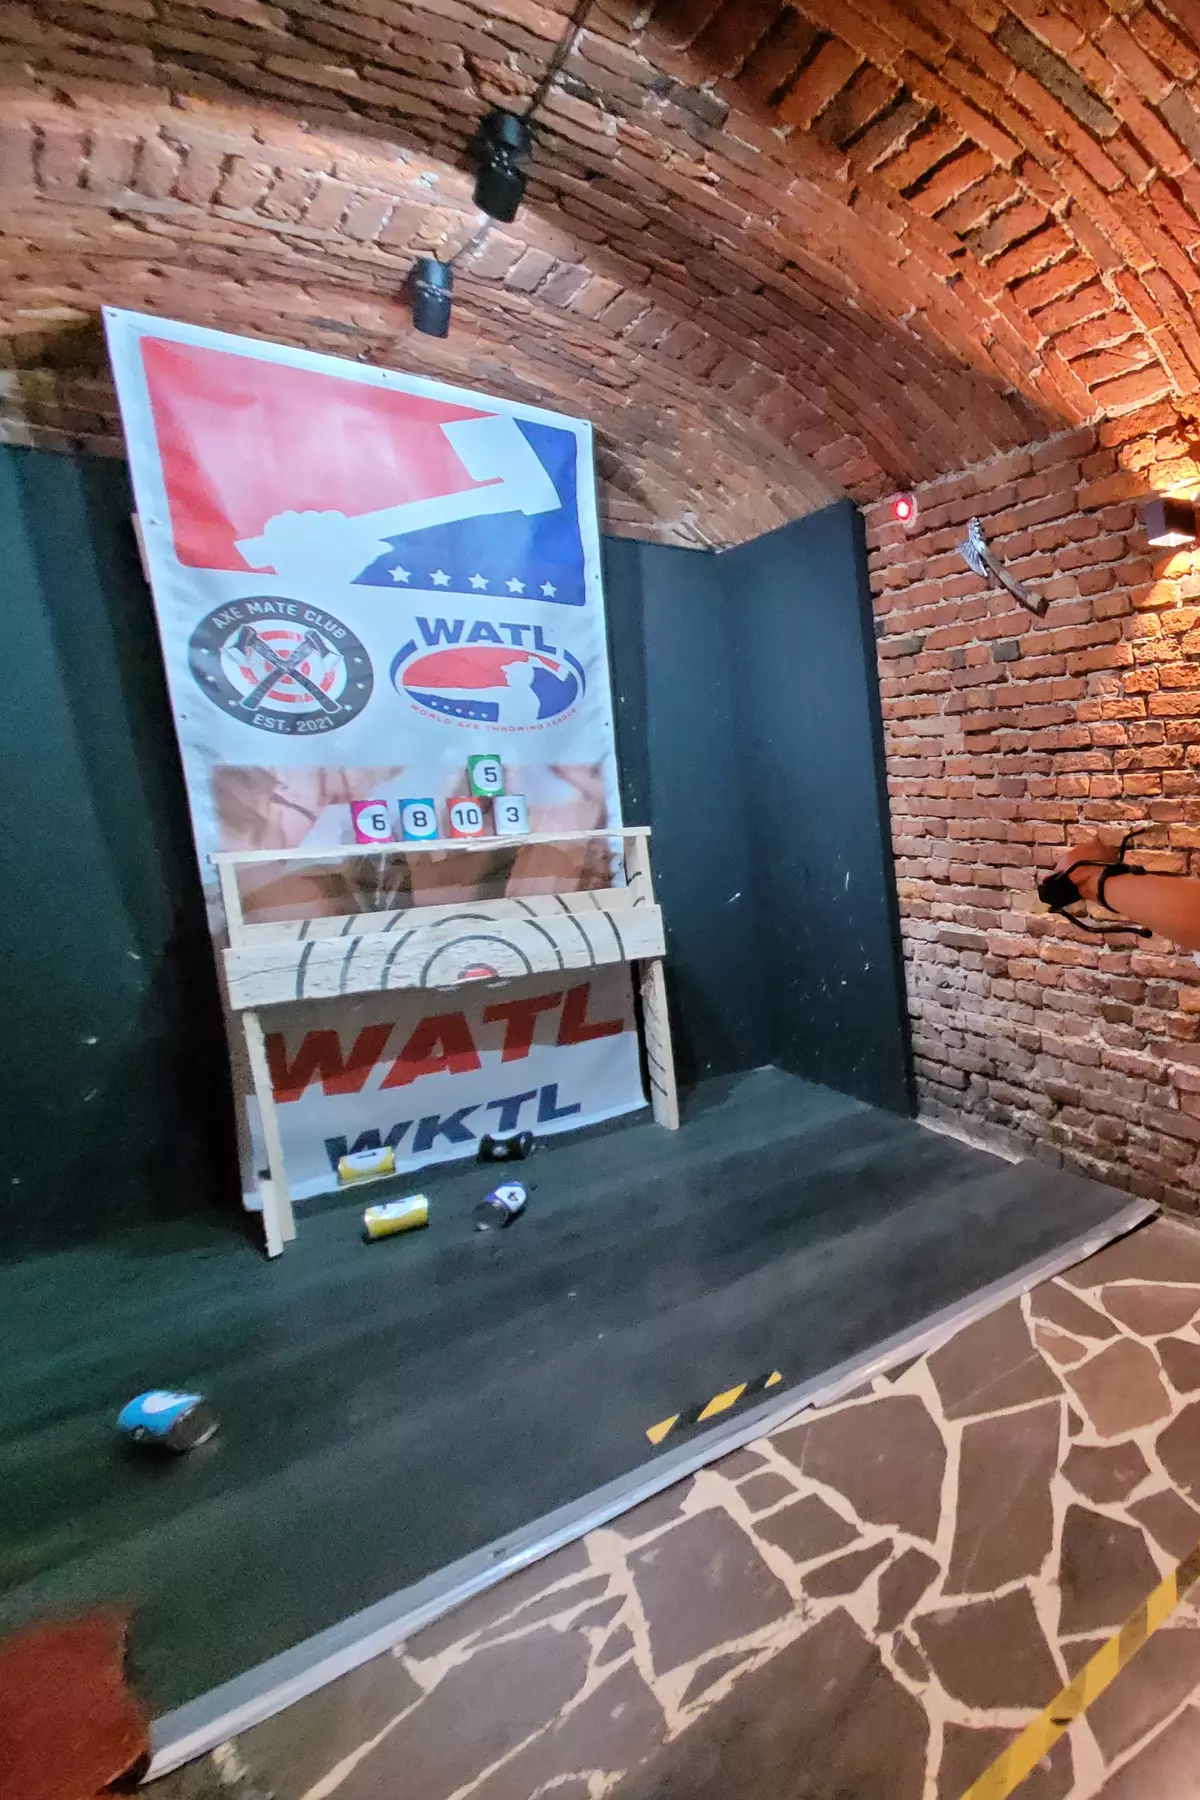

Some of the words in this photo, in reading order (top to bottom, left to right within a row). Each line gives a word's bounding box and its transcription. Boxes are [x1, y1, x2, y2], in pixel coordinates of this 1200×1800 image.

[211, 606, 244, 630] AXE
[246, 602, 298, 617] MATE
[303, 610, 347, 639] CLUB
[414, 616, 557, 655] WATL
[253, 713, 291, 732] EST.
[296, 716, 334, 732] 2021
[410, 703, 453, 725] WORLD
[484, 766, 498, 783] 5
[372, 813, 386, 831] 6
[413, 810, 427, 827] 8
[455, 808, 479, 826] 10
[506, 806, 519, 823] 3
[267, 983, 625, 1104] WATL
[324, 1083, 582, 1173] WKTL
